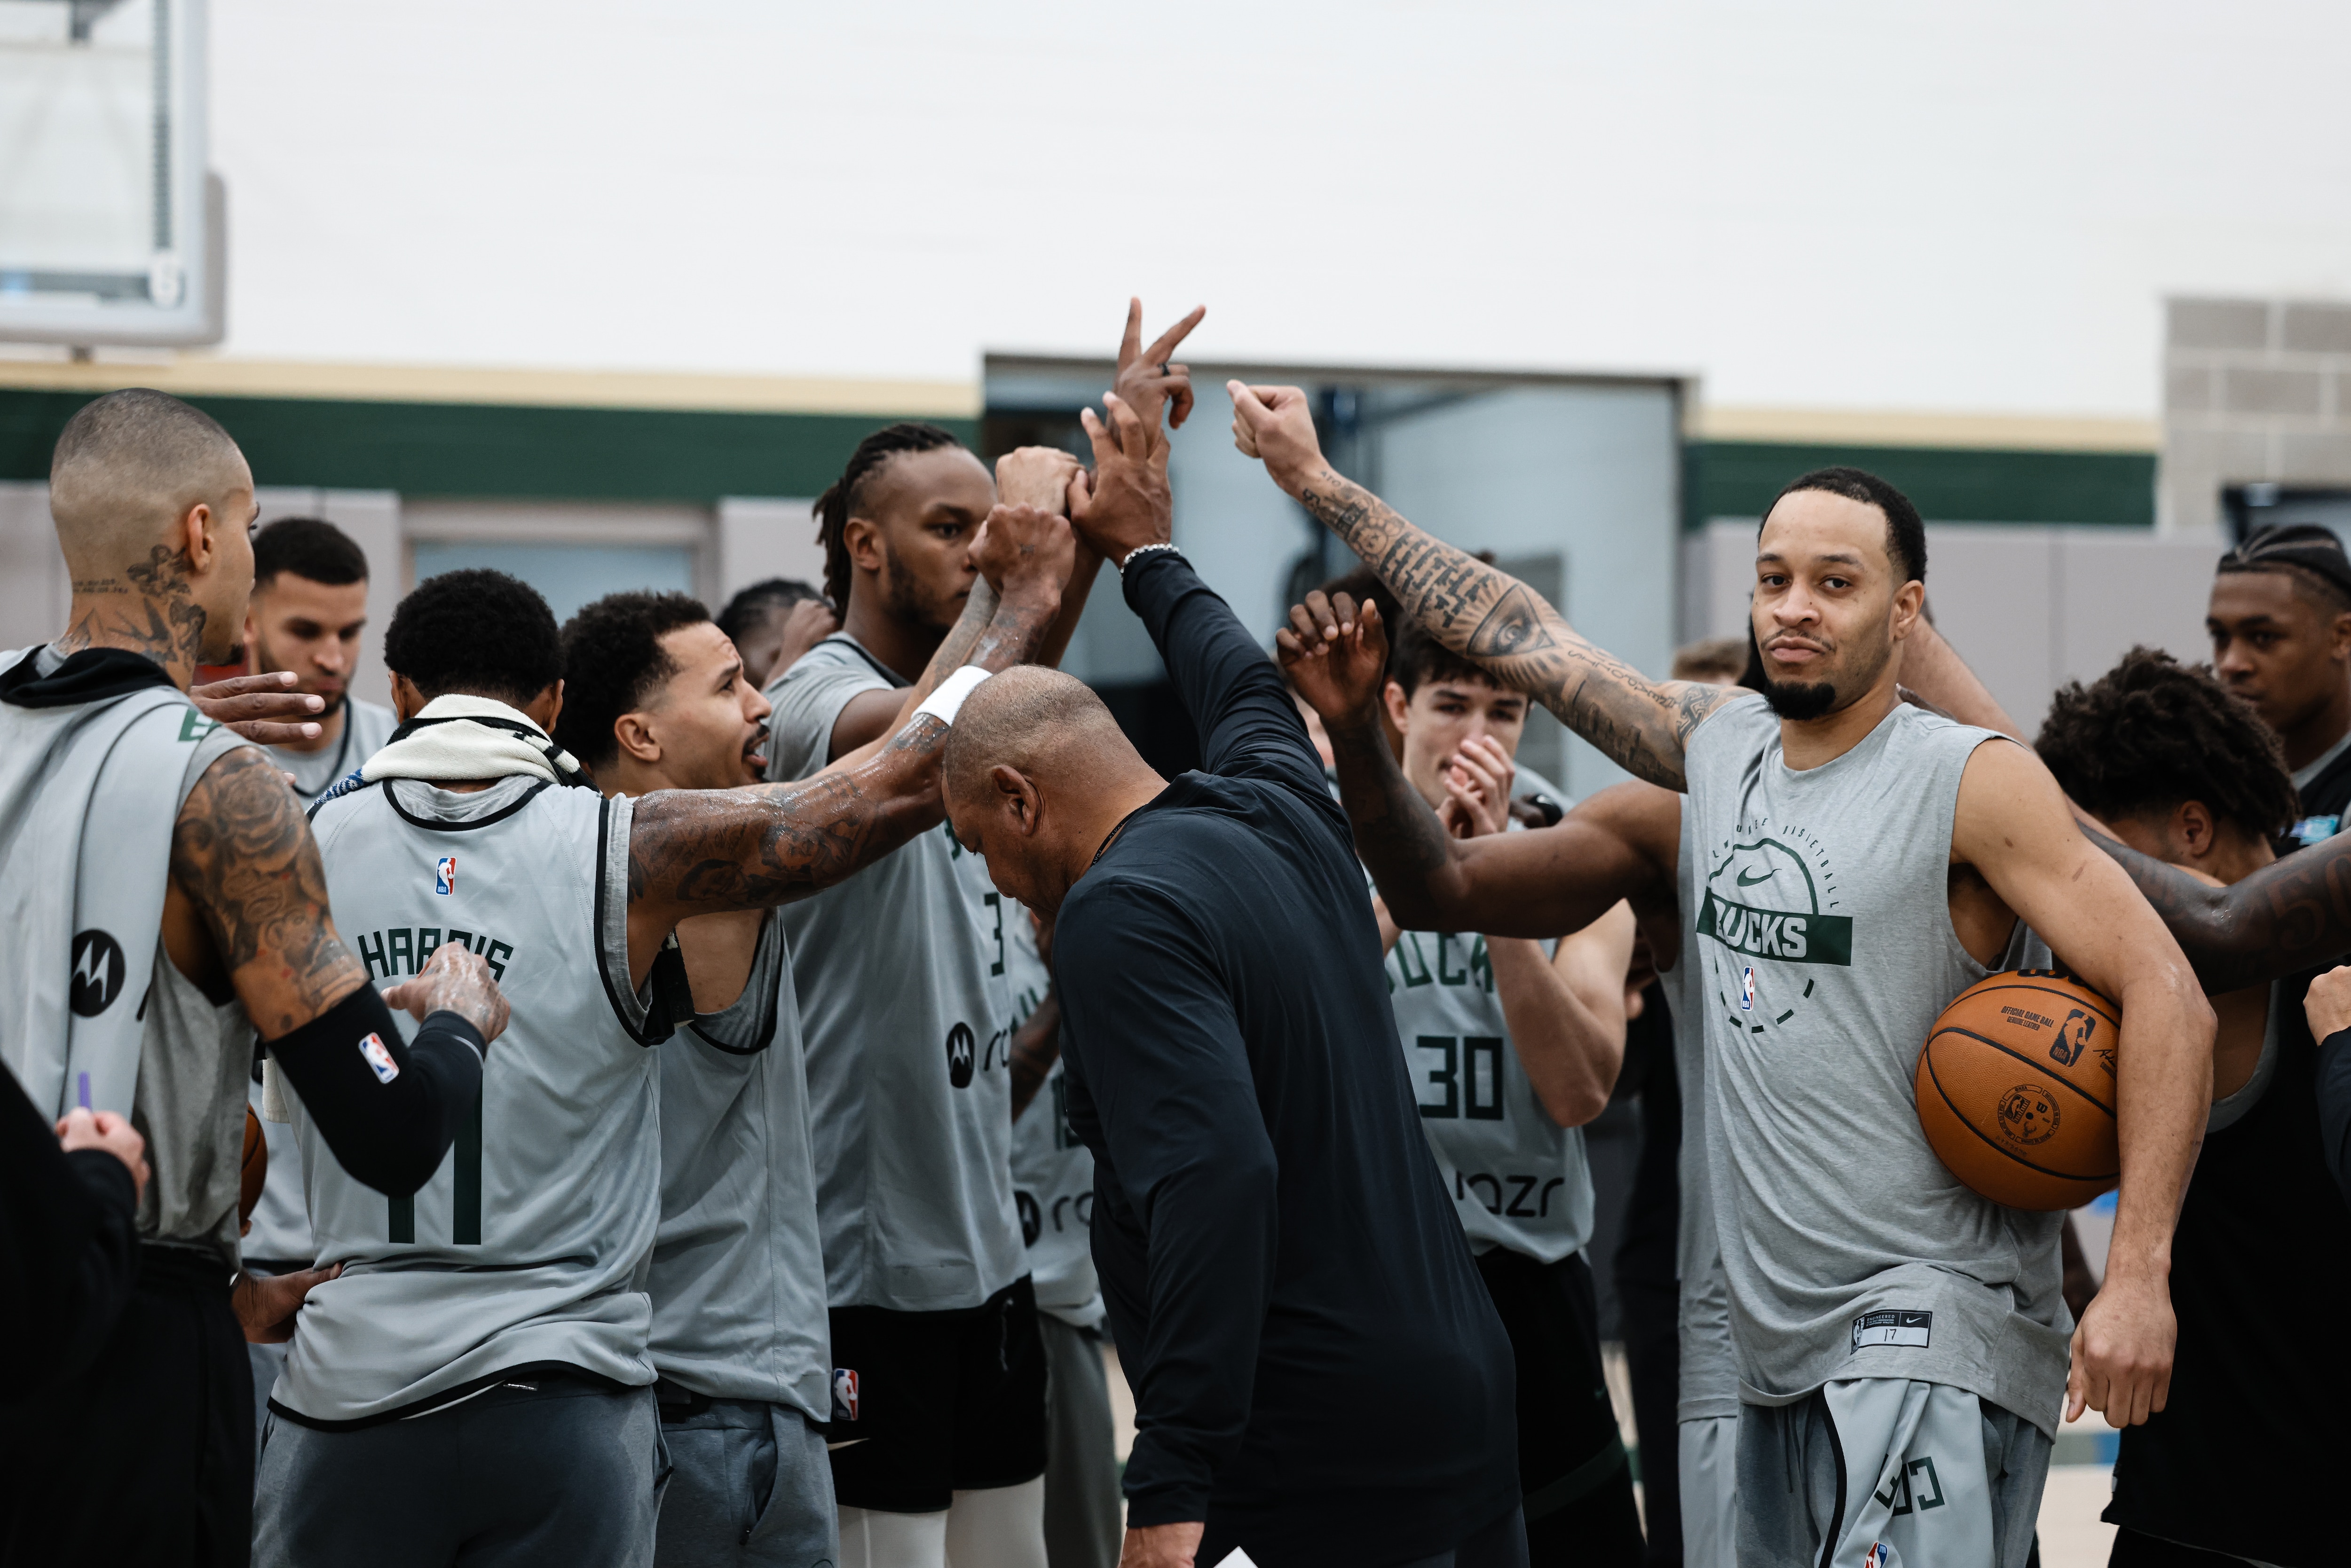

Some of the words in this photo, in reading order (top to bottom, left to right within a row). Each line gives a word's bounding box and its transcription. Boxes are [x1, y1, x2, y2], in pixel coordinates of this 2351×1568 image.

[1385, 930, 1495, 994] UCK
[2001, 1006, 2025, 1017] OFFICIAL
[2024, 1010, 2041, 1023] GAME
[2040, 1015, 2055, 1028] BALL
[2053, 1047, 2068, 1060] NBA
[1417, 1035, 1504, 1120] 30
[388, 1065, 482, 1245] 1
[1885, 1329, 1896, 1341] 17
